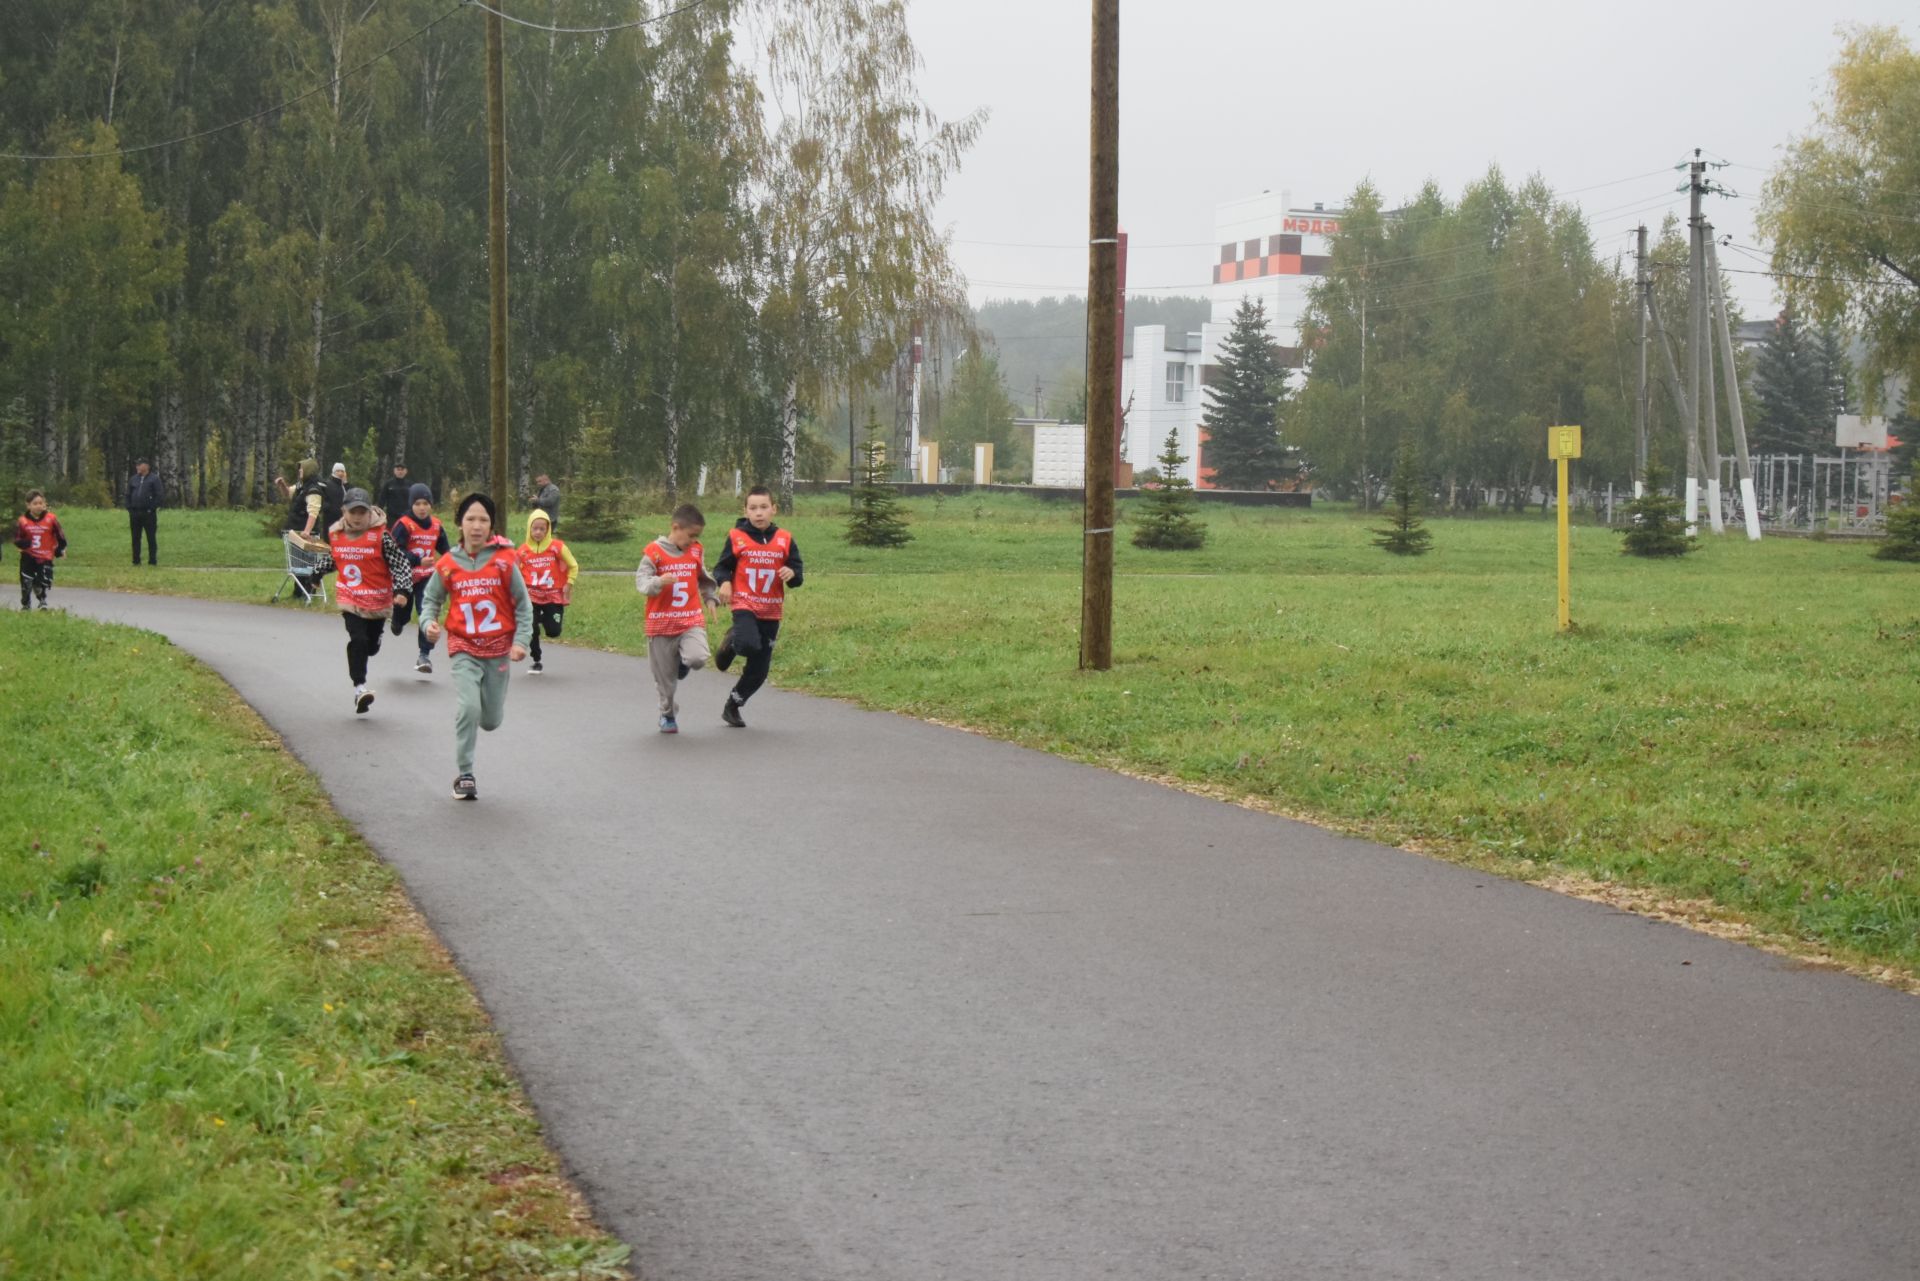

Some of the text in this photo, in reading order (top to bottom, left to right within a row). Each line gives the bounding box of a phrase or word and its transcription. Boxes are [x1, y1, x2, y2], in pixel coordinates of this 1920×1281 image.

[32, 535, 41, 549] 3
[334, 546, 375, 555] УКАЕВСКИЙ
[340, 553, 364, 561] РАЙОН
[749, 557, 775, 565] РАЙОН
[343, 564, 362, 587] 9
[531, 570, 554, 588] 14
[745, 568, 776, 594] 17
[461, 586, 493, 598] РАЙОН
[671, 582, 689, 608] 5
[460, 599, 502, 634] 12
